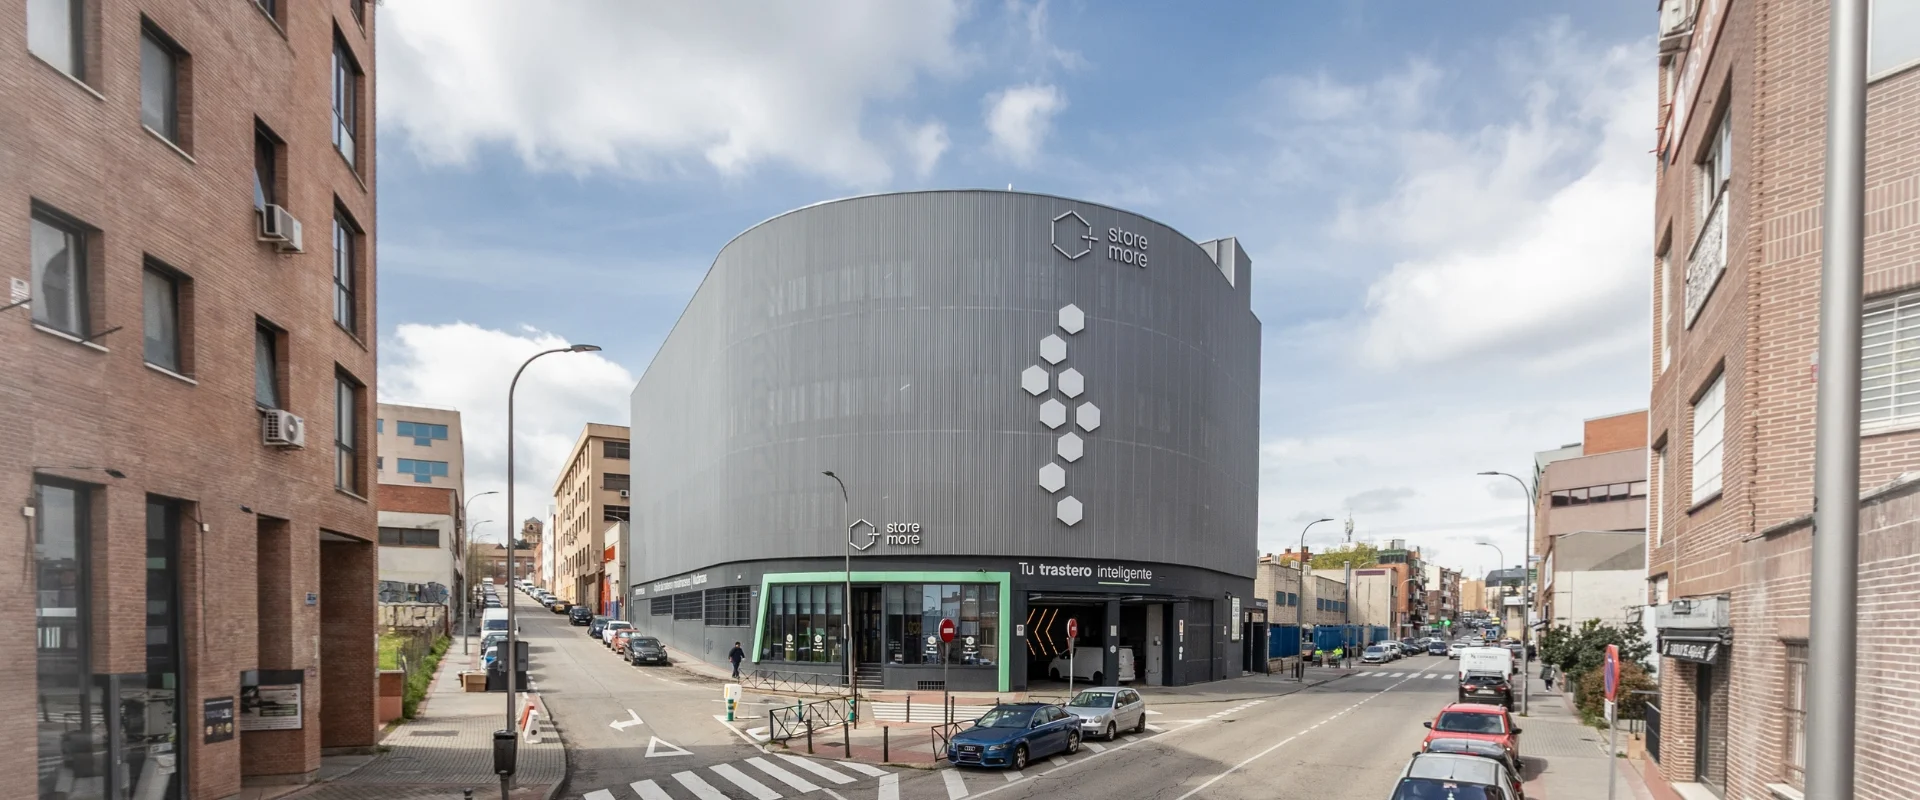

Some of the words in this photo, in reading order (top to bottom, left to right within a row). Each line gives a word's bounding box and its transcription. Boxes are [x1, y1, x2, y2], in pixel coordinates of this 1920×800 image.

[1108, 227, 1148, 250] store
[1108, 245, 1148, 268] more
[886, 521, 920, 533] store
[886, 534, 920, 545] more
[1019, 562, 1034, 575] Tu
[1039, 563, 1092, 577] trastero
[1097, 564, 1152, 582] inteligente
